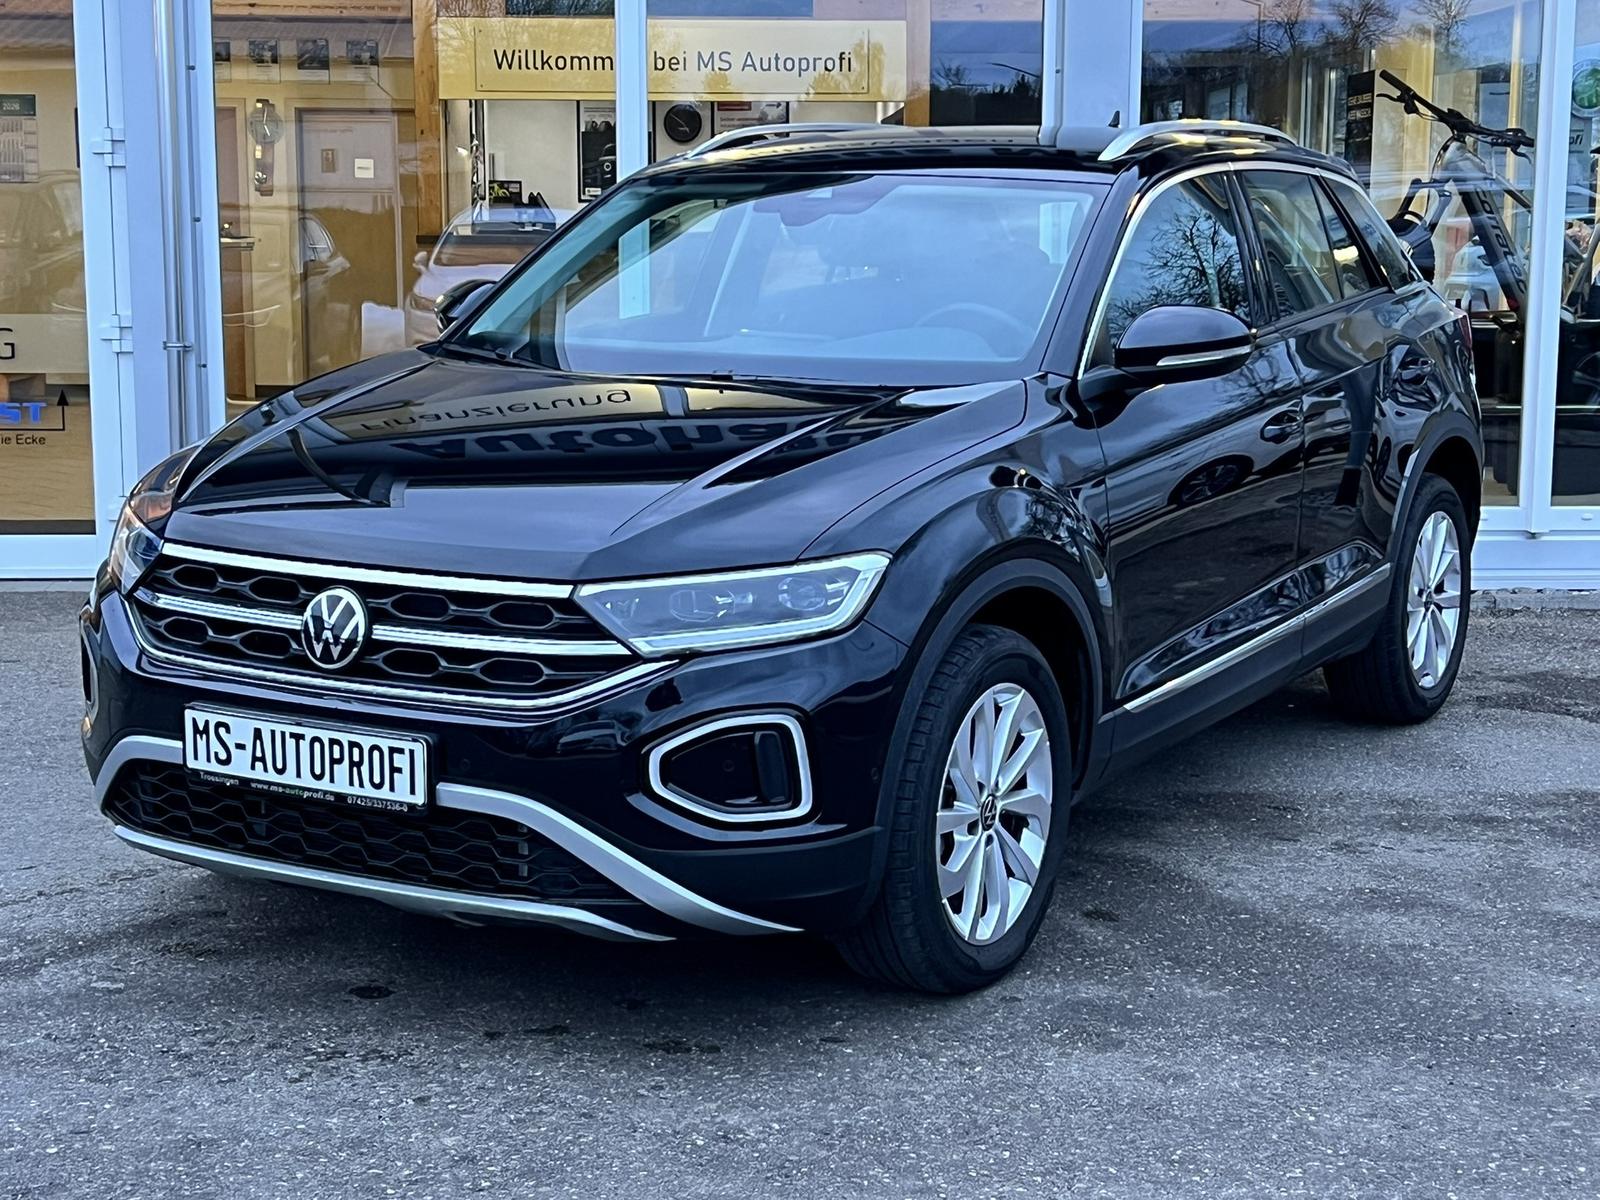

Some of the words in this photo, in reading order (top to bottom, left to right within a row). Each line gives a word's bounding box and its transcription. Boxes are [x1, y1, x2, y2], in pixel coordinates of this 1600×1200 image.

[494, 49, 614, 70] Willkomm
[653, 51, 687, 72] bei
[697, 51, 733, 72] MS
[741, 51, 852, 77] Autoprofi
[15, 433, 46, 445] Ecke
[192, 716, 416, 796] MS-AUTOPROFI
[200, 772, 240, 787] Trossingen
[250, 781, 336, 801] www.ms-autoprofi.de
